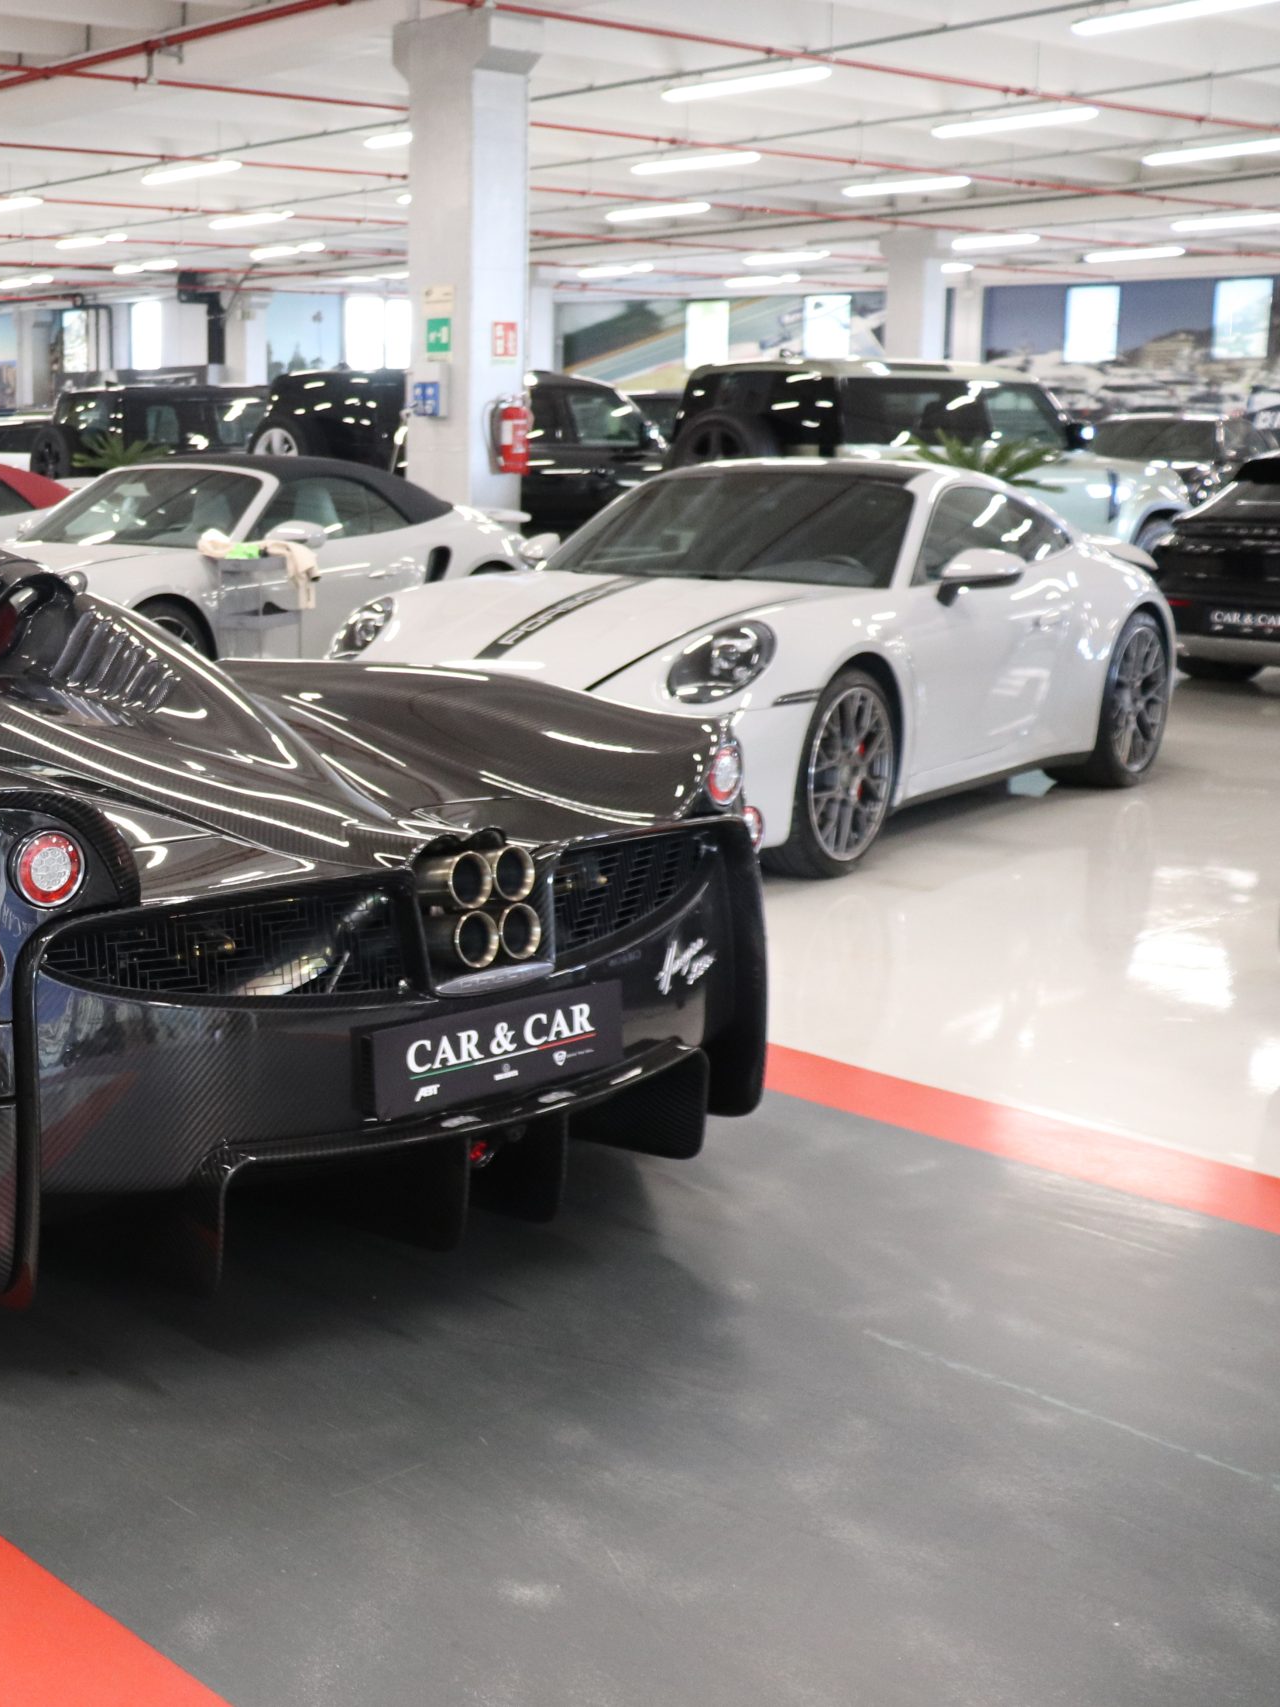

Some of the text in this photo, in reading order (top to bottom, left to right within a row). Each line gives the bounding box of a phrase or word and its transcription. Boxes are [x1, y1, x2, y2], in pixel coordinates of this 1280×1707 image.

[1214, 611, 1240, 624] CAR
[406, 1003, 596, 1073] CAR & CAR
